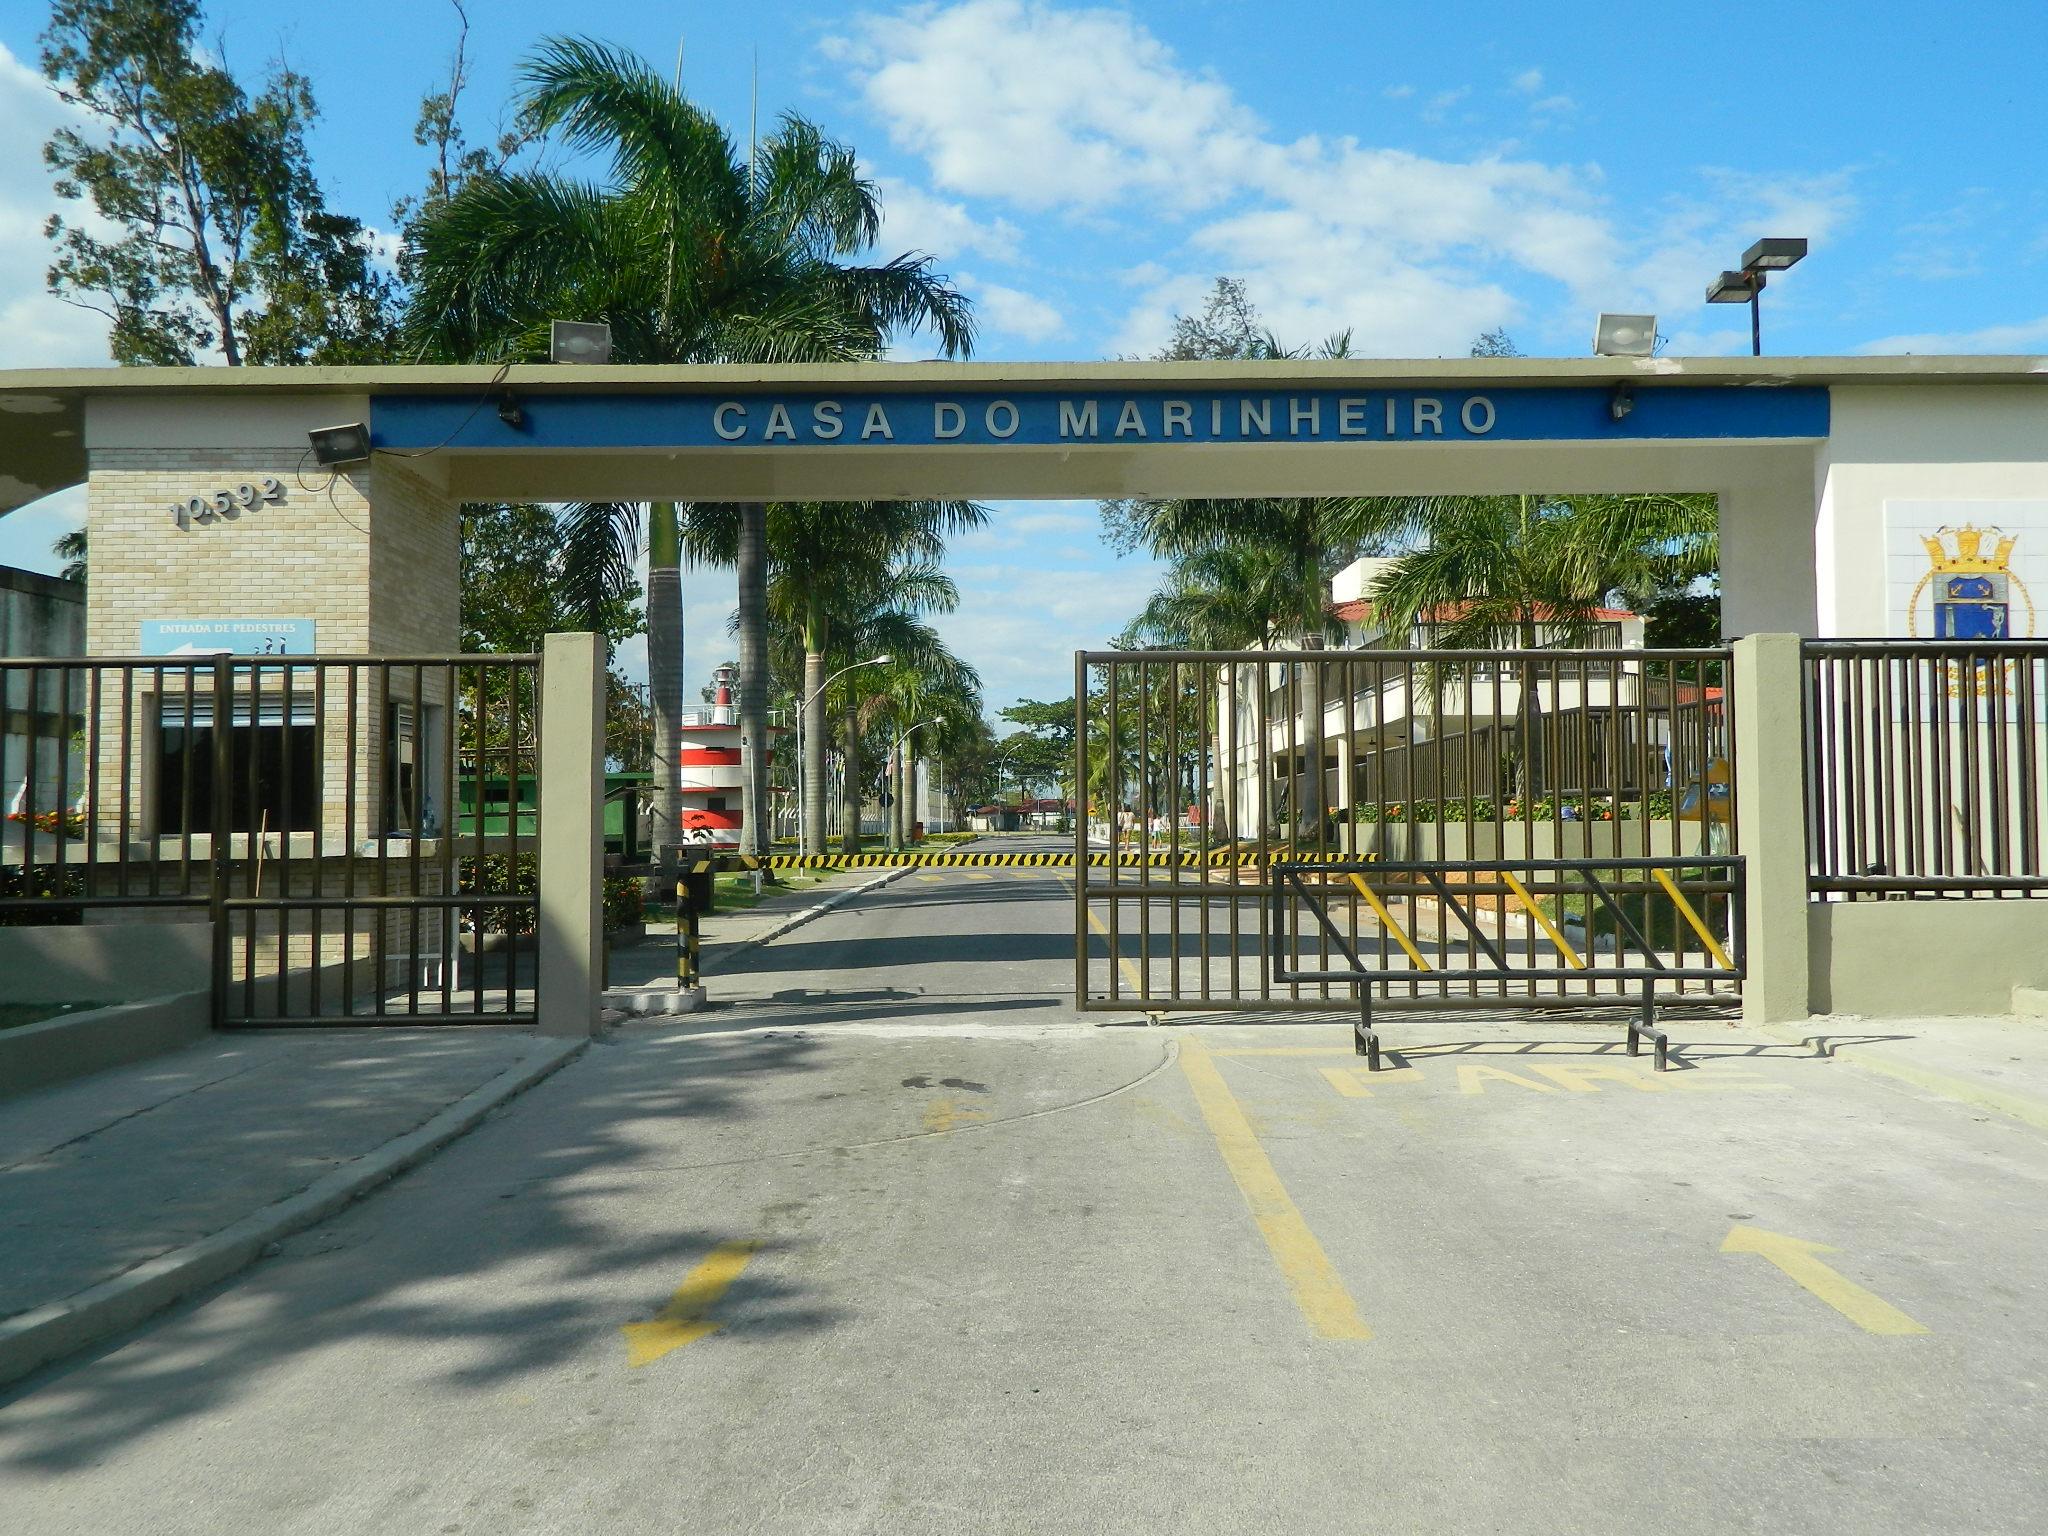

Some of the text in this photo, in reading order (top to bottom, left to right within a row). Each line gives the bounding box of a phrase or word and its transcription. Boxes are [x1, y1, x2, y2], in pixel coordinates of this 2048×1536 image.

[713, 396, 1496, 440] CASA DO MARINHEIRO
[169, 476, 278, 524] 10.592
[160, 623, 296, 633] ENTRADA DE PEDESTRES
[1319, 1063, 1794, 1098] PARE
